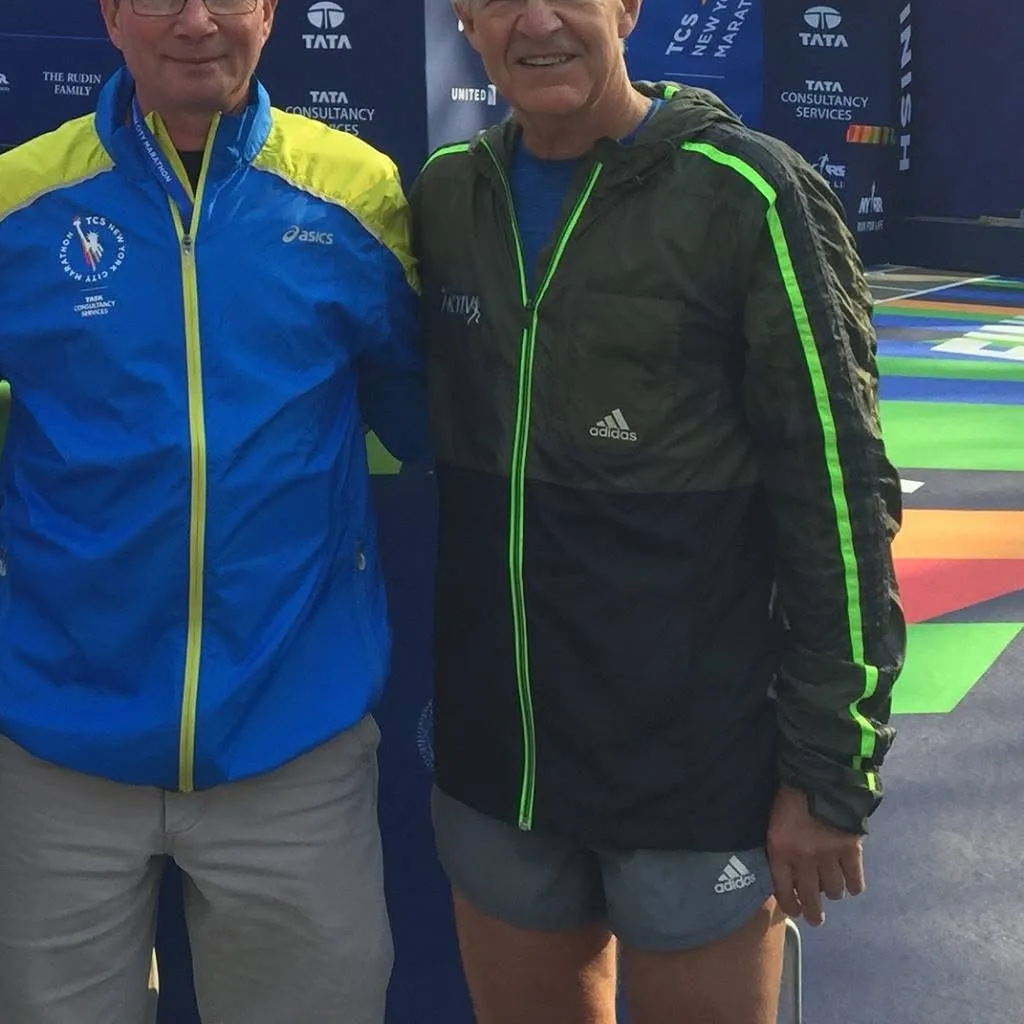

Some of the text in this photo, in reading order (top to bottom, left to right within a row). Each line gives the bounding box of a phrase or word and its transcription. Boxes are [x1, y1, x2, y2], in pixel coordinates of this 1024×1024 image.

[302, 33, 352, 50] TATA
[666, 13, 699, 55] TCS
[691, 16, 720, 56] NEW
[799, 33, 848, 48] TATA
[43, 72, 101, 84] THE RUDIN
[54, 84, 92, 96] FAMILY
[451, 87, 487, 101] UNITED
[805, 80, 843, 93] TATA
[310, 91, 349, 104] TATA
[780, 91, 869, 109] CONSULTANCY
[795, 107, 852, 121] SERVICES
[144, 141, 173, 183] MARATHON
[298, 230, 334, 245] asics
[59, 216, 126, 282] TCS NEW YORK CITY MARATHON
[589, 426, 637, 441] adidas
[714, 873, 756, 893] adidas
